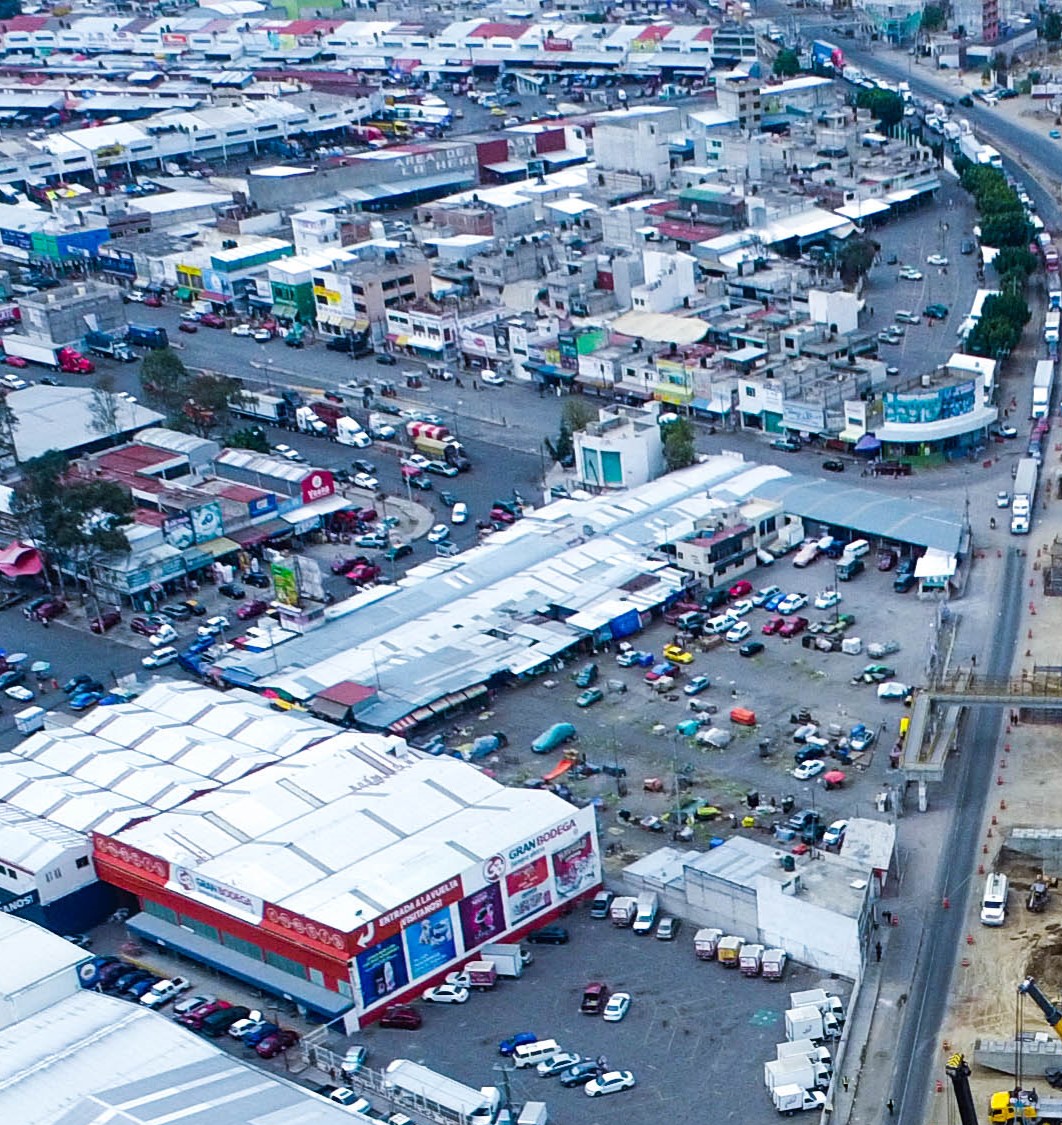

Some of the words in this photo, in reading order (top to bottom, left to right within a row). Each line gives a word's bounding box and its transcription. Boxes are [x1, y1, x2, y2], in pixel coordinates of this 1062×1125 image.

[509, 839, 536, 860] GRAN
[536, 819, 576, 846] BODEGA
[379, 901, 416, 927] ENTRADA
